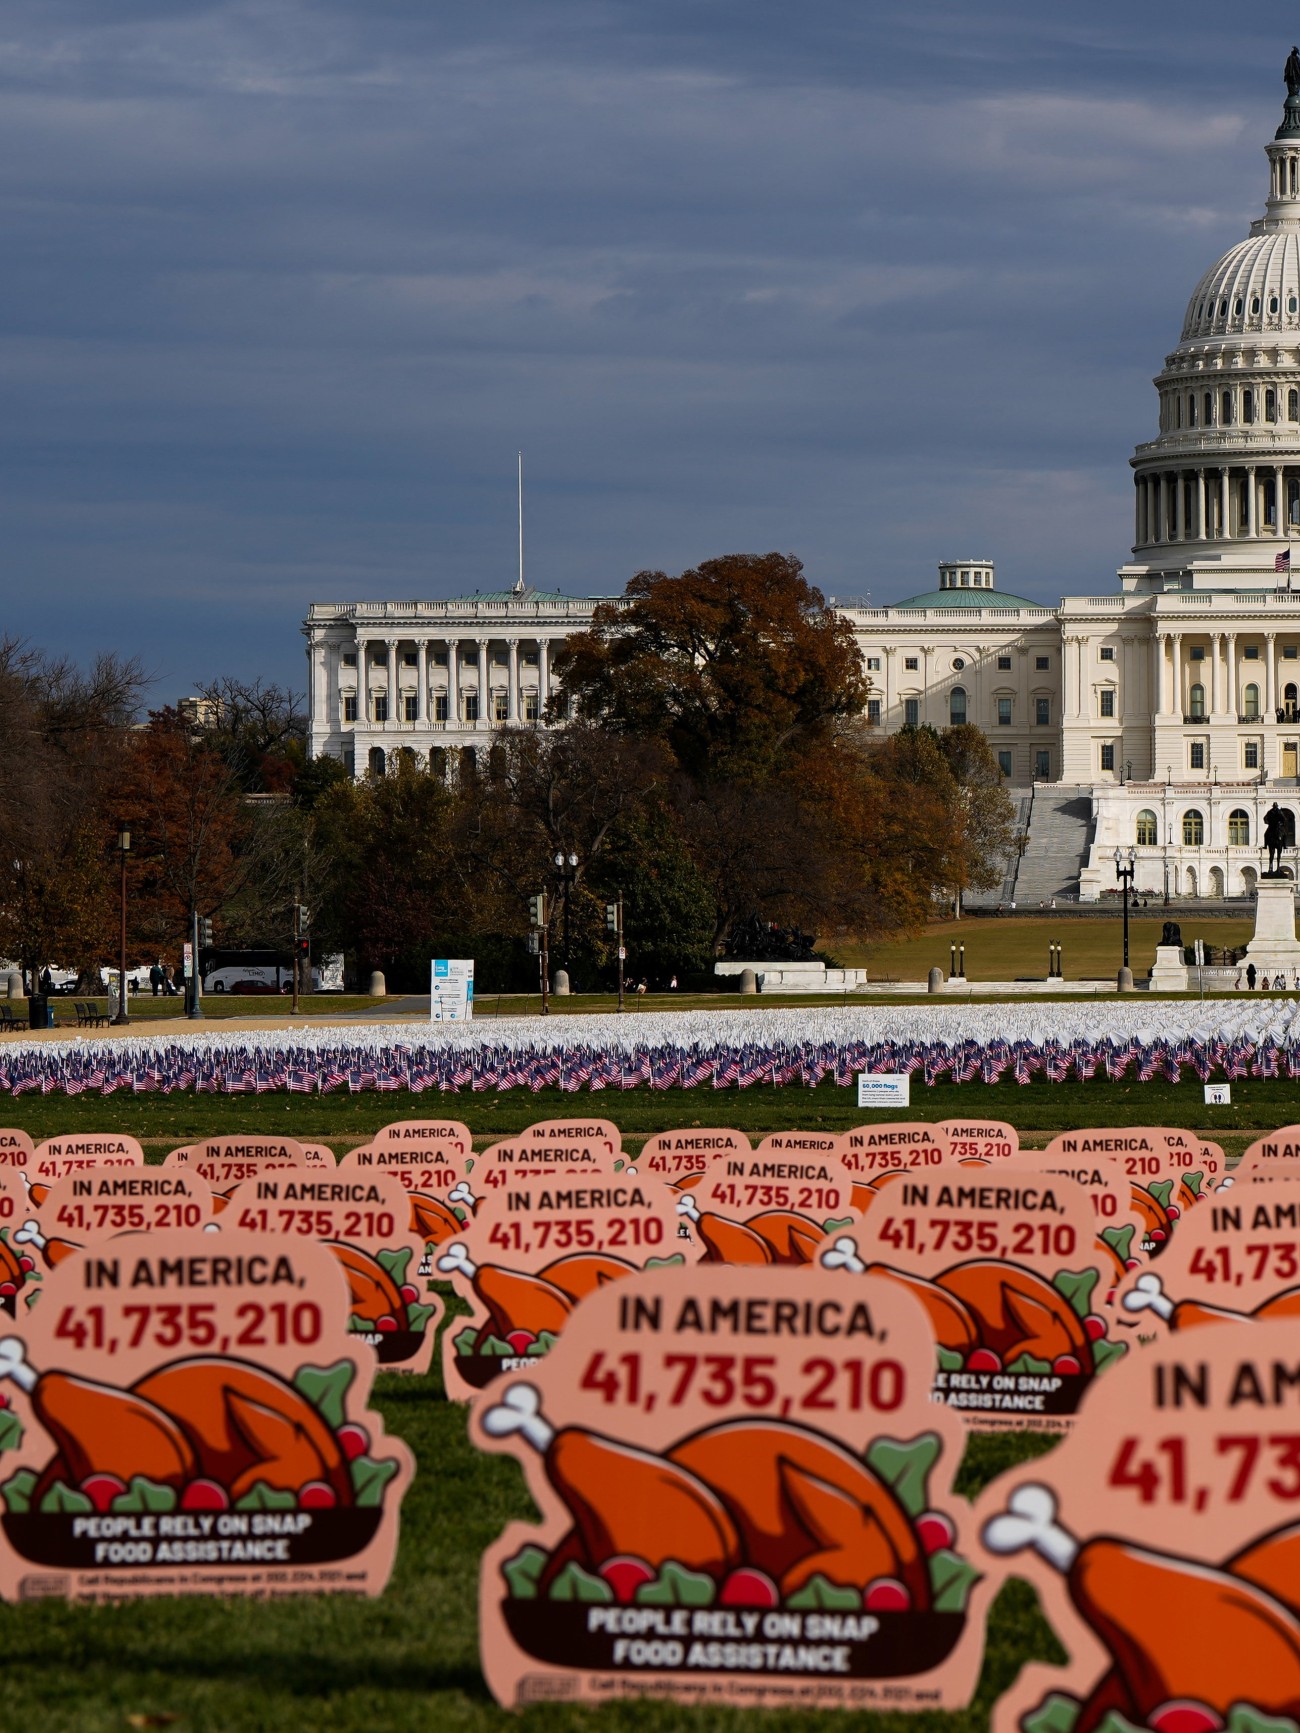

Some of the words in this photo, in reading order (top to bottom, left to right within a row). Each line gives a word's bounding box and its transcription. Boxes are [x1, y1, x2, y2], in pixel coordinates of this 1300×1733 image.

[389, 1129, 400, 1138] IN
[403, 1128, 458, 1138] AMERICA,
[533, 1129, 545, 1137] IN
[549, 1127, 607, 1138] AMERICA,
[659, 1140, 671, 1150] IN
[675, 1137, 737, 1150] AMERICA,
[772, 1139, 782, 1148] IN
[850, 1136, 863, 1147] IN
[868, 1131, 934, 1146] AMERICA,
[952, 1128, 1006, 1139] AMERICA,
[49, 1145, 61, 1155] IN
[66, 1143, 128, 1155] AMERICA,
[207, 1146, 220, 1157] IN
[224, 1146, 291, 1158] AMERICA,
[498, 1150, 513, 1162] IN
[518, 1149, 596, 1163] AMERICA,
[1063, 1140, 1077, 1152] IN
[1082, 1139, 1153, 1152] AMERICA,
[1263, 1144, 1277, 1157] IN
[178, 1153, 188, 1161] IN
[358, 1153, 372, 1165] IN
[377, 1151, 448, 1165] AMERICA,
[841, 1148, 942, 1173] 41,735,210
[727, 1162, 744, 1176] IN
[749, 1163, 833, 1182] AMERICA,
[73, 1181, 91, 1196] IN
[98, 1180, 191, 1197] AMERICA,
[258, 1183, 277, 1199] IN
[284, 1183, 385, 1205] AMERICA,
[508, 1192, 530, 1211] IN
[538, 1188, 651, 1210] AMERICA,
[711, 1183, 840, 1209] 41,735,210
[903, 1185, 928, 1206] IN
[936, 1186, 1064, 1215] AMERICA,
[57, 1204, 200, 1232] 41,735,210
[1212, 1207, 1241, 1231] IN
[489, 1217, 663, 1255] 41,735,210
[879, 1217, 1076, 1259] 41,735,210
[85, 1260, 119, 1288] IN
[130, 1256, 305, 1288] AMERICA,
[55, 1301, 322, 1356] 41,735,210
[620, 1296, 661, 1331] IN
[675, 1297, 887, 1342] AMERICA,
[580, 1351, 905, 1421] 41,735,210
[950, 1374, 990, 1389] RELY
[993, 1376, 1015, 1389] ON
[1018, 1377, 1062, 1391] SNAP
[1155, 1364, 1208, 1408] IN
[945, 1392, 1044, 1412] ASSISTANCE
[74, 1517, 155, 1537] PEOPLE
[159, 1516, 213, 1536] RELY
[218, 1516, 248, 1534] ON
[252, 1514, 311, 1534] SNAP
[96, 1542, 152, 1562] FOOD
[156, 1539, 288, 1561] ASSISTANCE
[588, 1608, 688, 1635] PEOPLE
[693, 1611, 759, 1636] RELY
[764, 1614, 801, 1637] ON
[806, 1615, 878, 1640] SNAP
[614, 1640, 683, 1665] FOOD
[687, 1642, 849, 1671] ASSISTANCE
